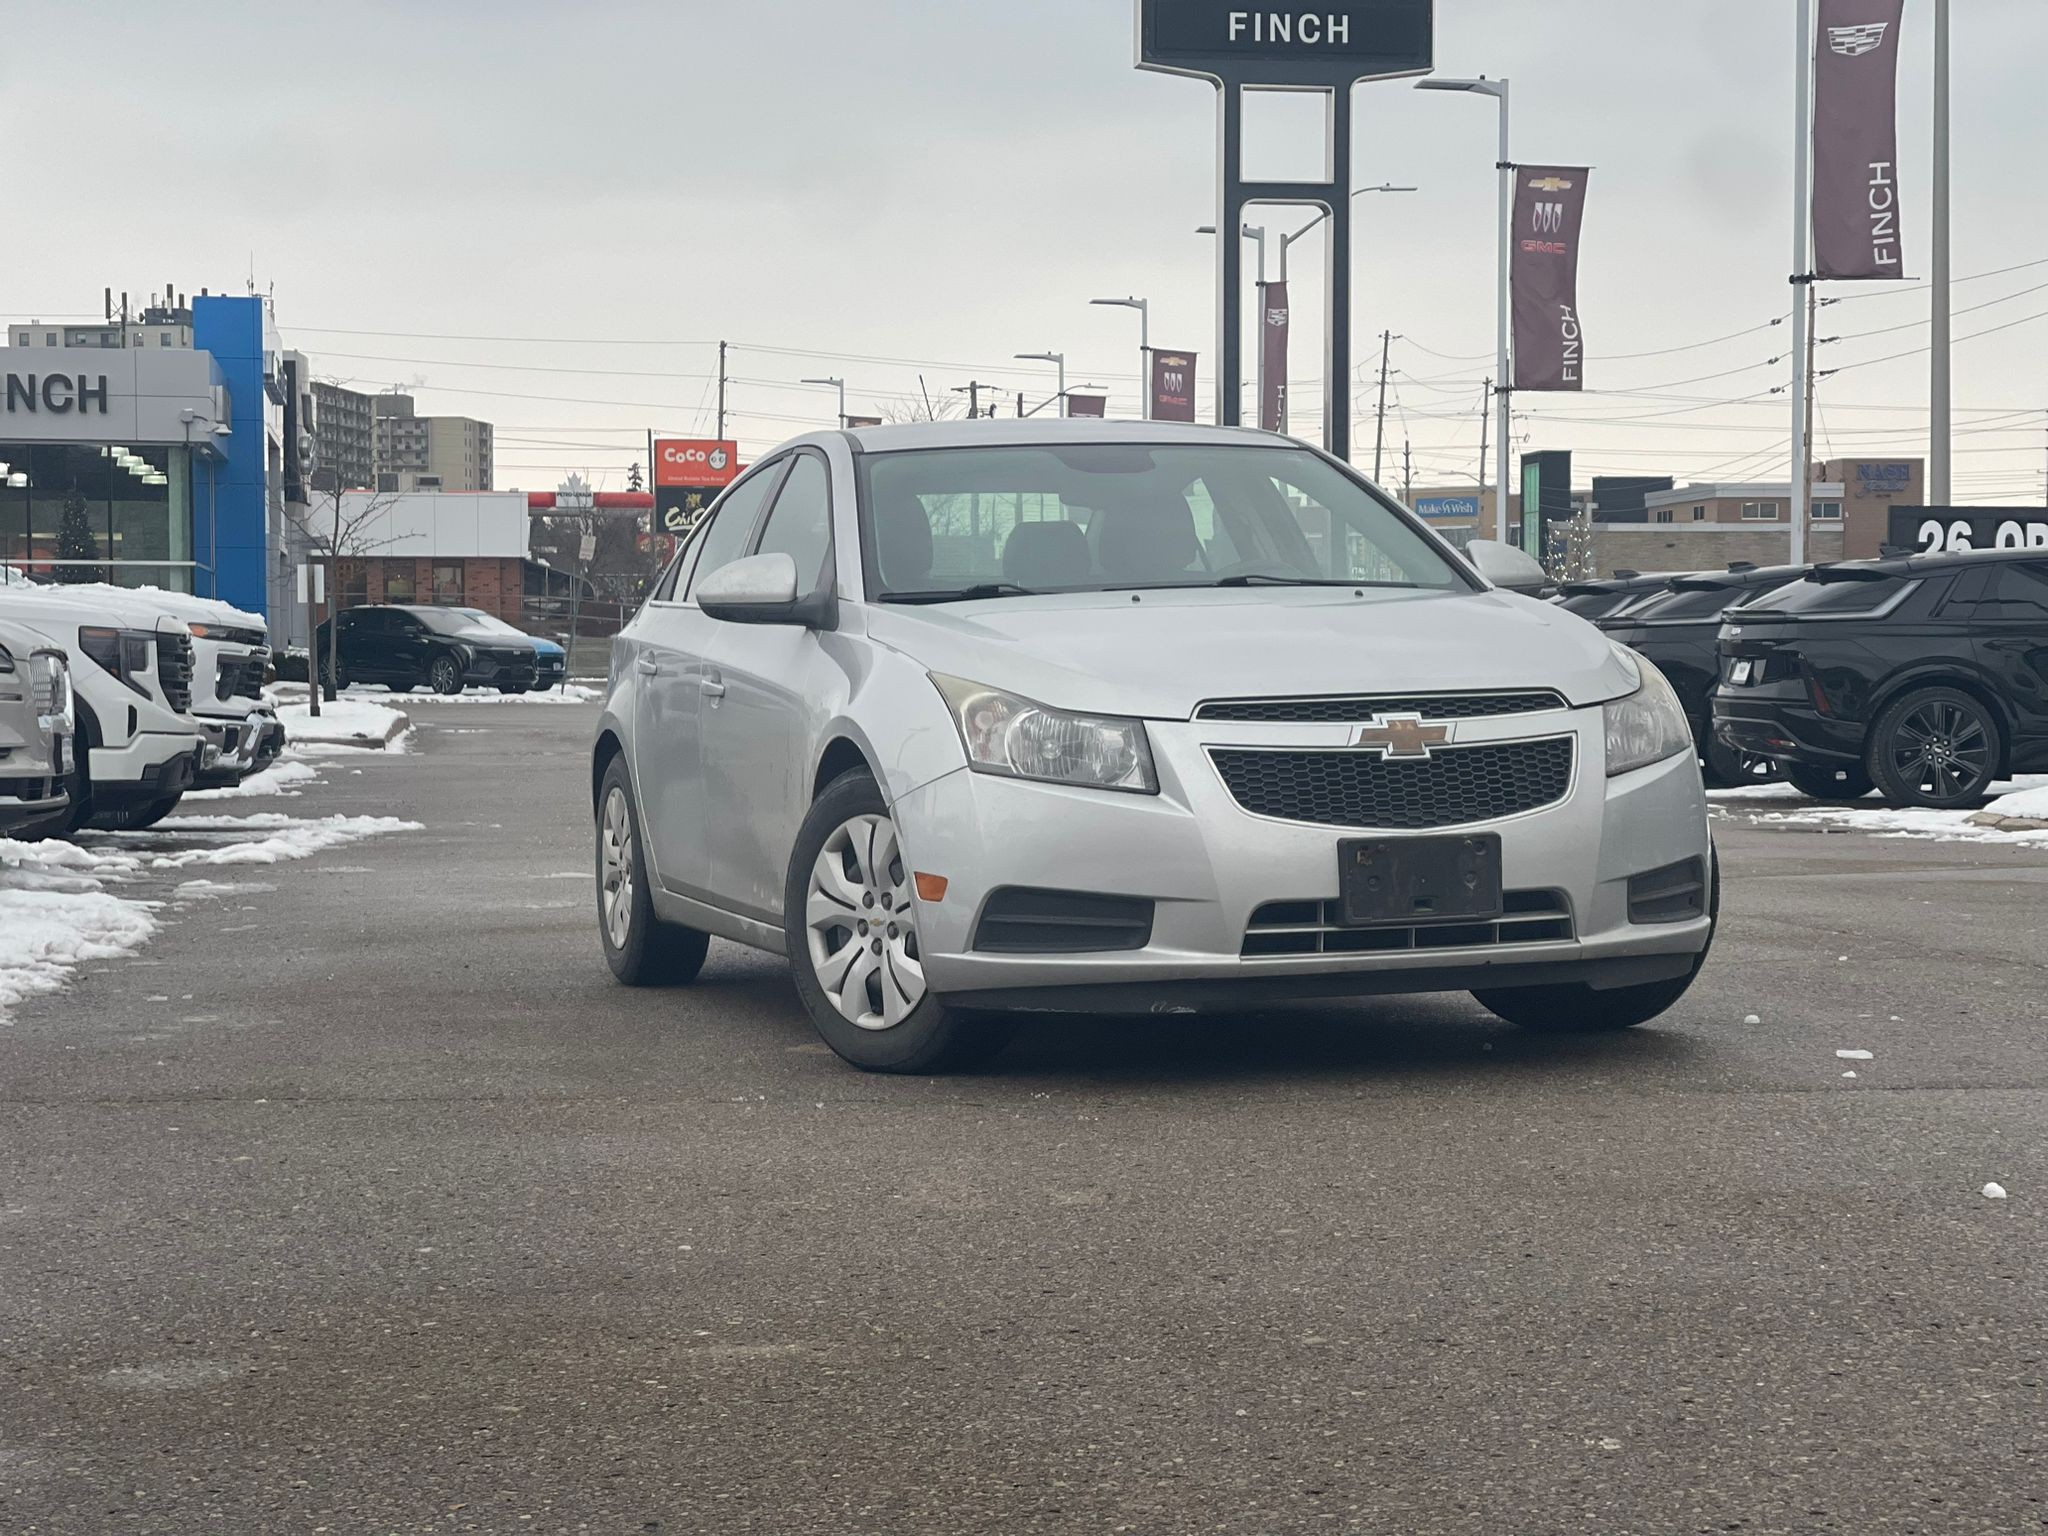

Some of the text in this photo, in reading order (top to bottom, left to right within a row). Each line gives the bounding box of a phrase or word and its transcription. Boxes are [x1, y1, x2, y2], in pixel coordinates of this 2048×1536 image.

[1228, 11, 1349, 44] FINCH
[1868, 161, 1897, 265] FINCH
[1520, 239, 1567, 254] GMC
[1559, 304, 1579, 382] FINCH
[7, 373, 107, 414] NCH
[664, 447, 706, 464] CoCo
[1856, 463, 1911, 481] NASH
[1918, 520, 1973, 553] 26
